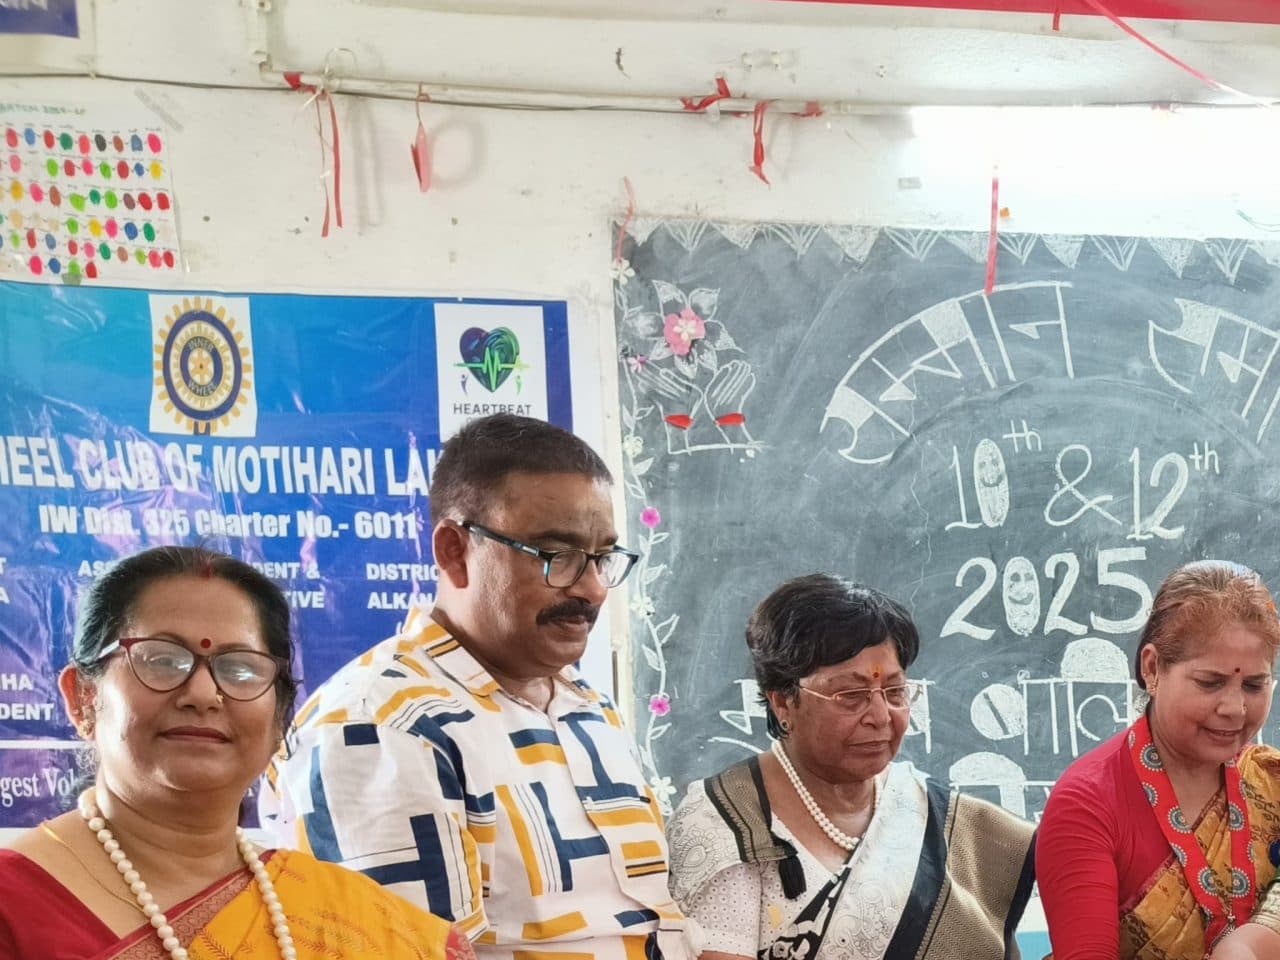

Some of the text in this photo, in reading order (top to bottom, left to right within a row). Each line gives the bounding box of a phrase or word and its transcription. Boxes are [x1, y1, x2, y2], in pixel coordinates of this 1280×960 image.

[453, 402, 532, 416] HEARTBEAT
[78, 439, 161, 491] CLUB
[164, 441, 203, 493] OF
[212, 445, 376, 496] MOTIHARI
[1044, 444, 1122, 527] &
[38, 504, 78, 534] IW
[144, 508, 191, 537] 325
[194, 508, 291, 538] Charter
[354, 511, 418, 541] 6011
[306, 563, 321, 579] &
[940, 546, 1152, 638] 2025
